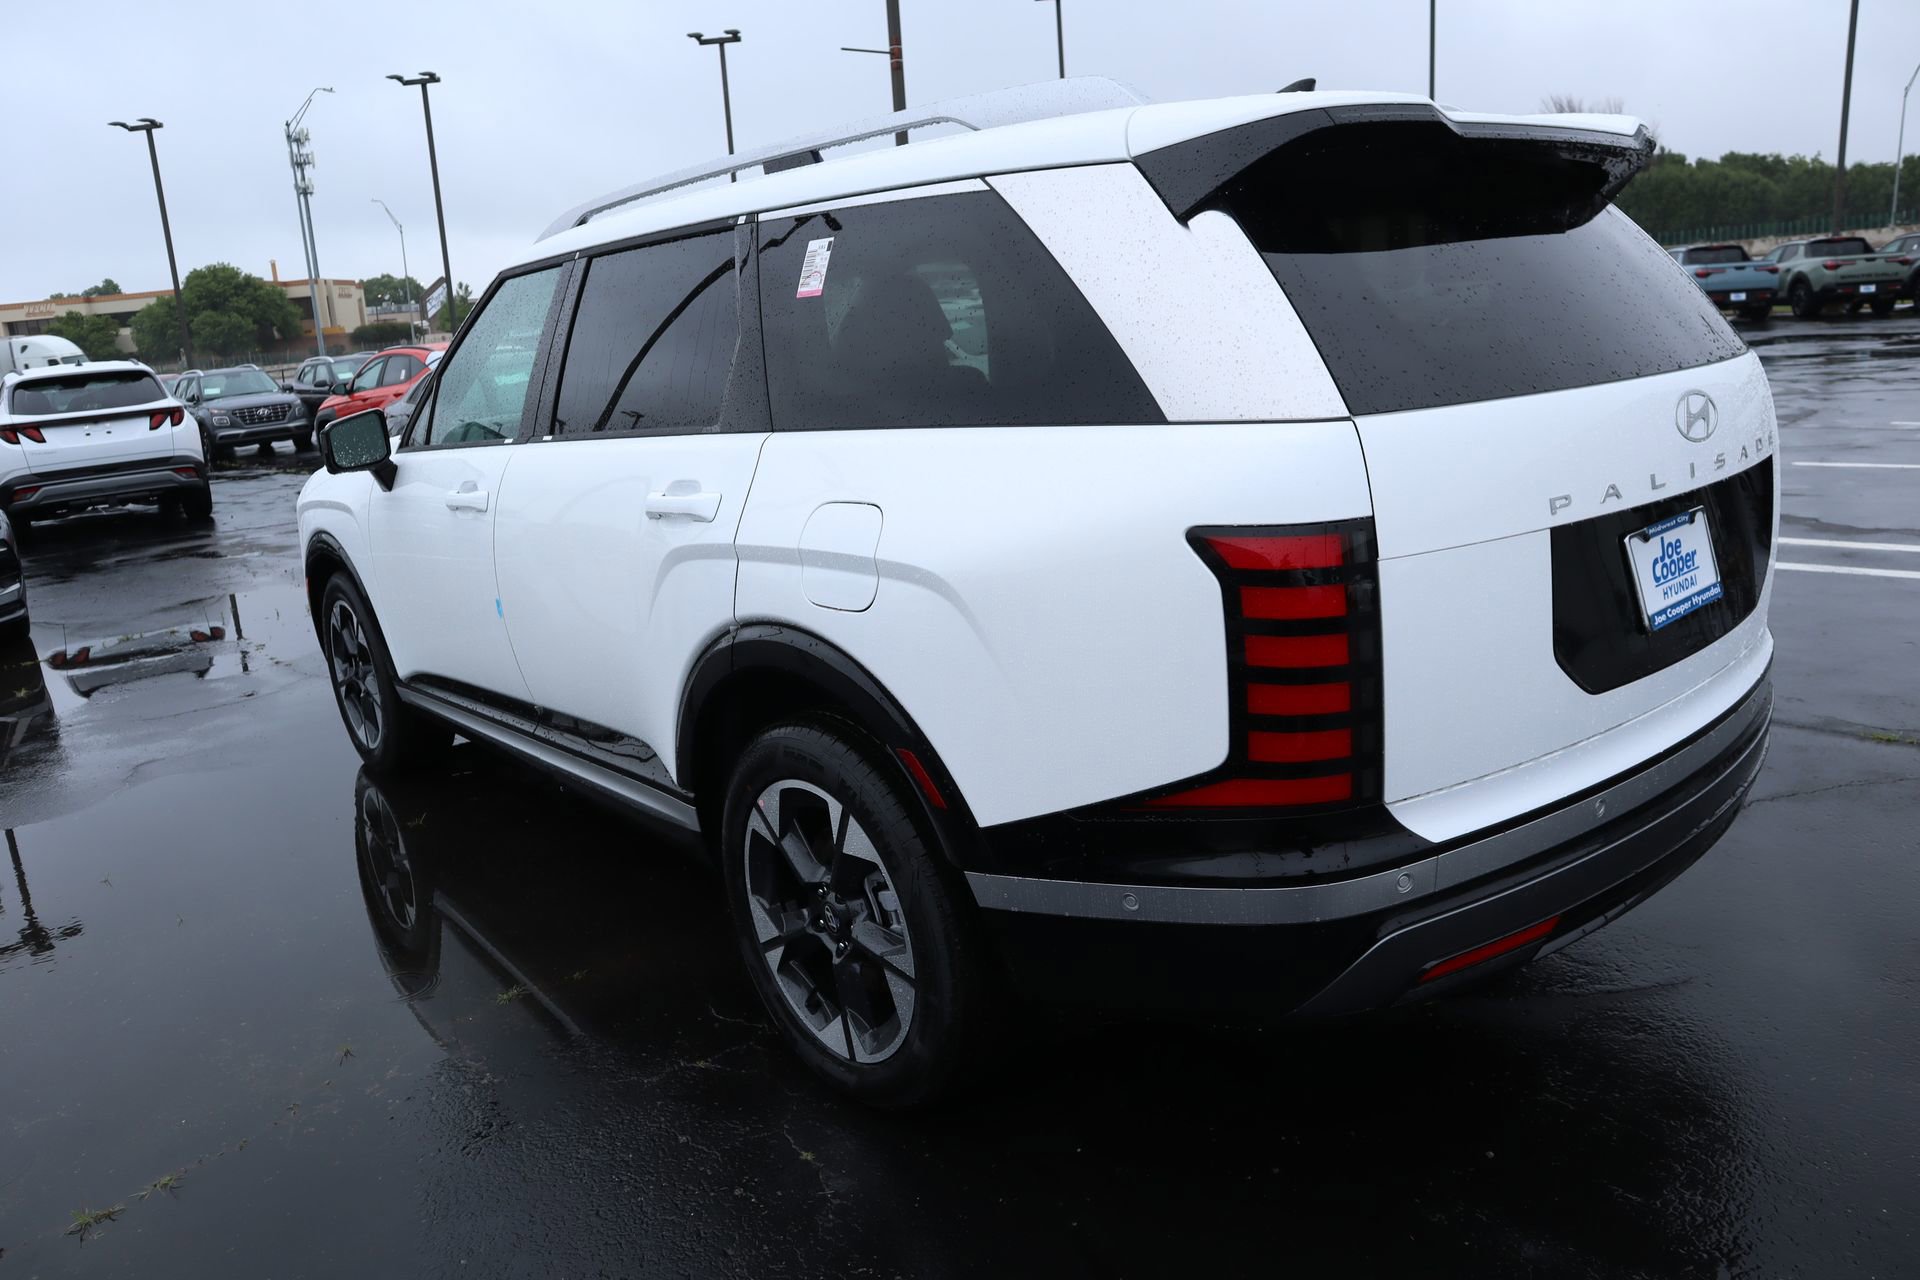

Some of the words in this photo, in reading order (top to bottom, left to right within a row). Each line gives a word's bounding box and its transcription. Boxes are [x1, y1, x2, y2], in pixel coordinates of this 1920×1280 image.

[1549, 433, 1773, 516] PALISADE
[1649, 520, 1676, 534] Midwest
[1677, 514, 1690, 523] City
[1660, 536, 1682, 563] Joe
[1652, 549, 1697, 583] Cooper
[1663, 574, 1698, 600] HYUNDAI
[1654, 613, 1667, 625] Joe
[1667, 600, 1692, 617] Cooper
[1692, 583, 1721, 605] Hyundai
